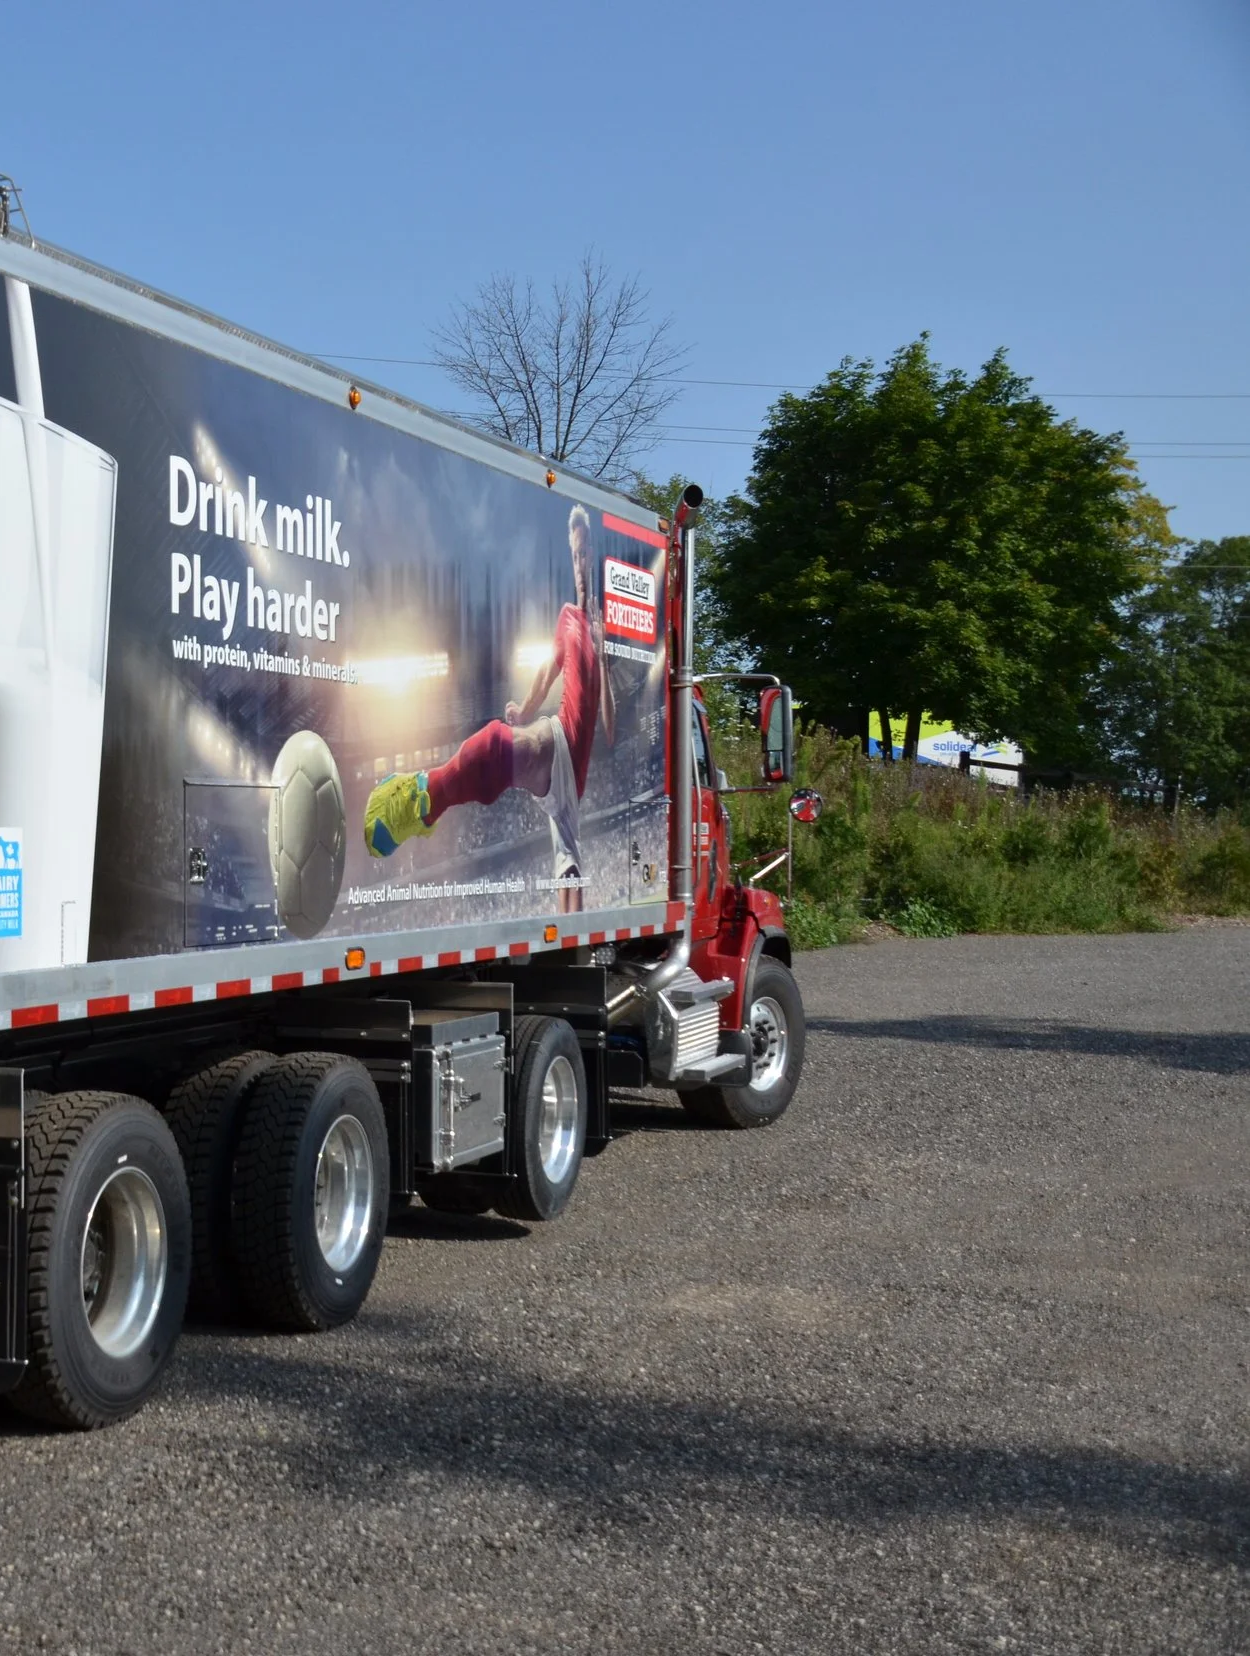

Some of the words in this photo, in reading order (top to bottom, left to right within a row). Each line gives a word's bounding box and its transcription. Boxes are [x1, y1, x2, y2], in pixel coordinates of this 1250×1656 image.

[169, 455, 269, 548] Drink
[276, 494, 350, 567] milk.
[170, 552, 240, 640] Play
[246, 566, 340, 642] harder
[610, 567, 630, 589] Grand
[606, 599, 654, 634] FORTIFIERS
[172, 635, 201, 661] with
[204, 642, 251, 671] protein,
[253, 648, 300, 676] vitamins
[302, 655, 311, 677] &
[348, 884, 386, 904] Advanced
[387, 882, 412, 901] Animal
[413, 882, 443, 899] Nutrition
[443, 881, 453, 897] for
